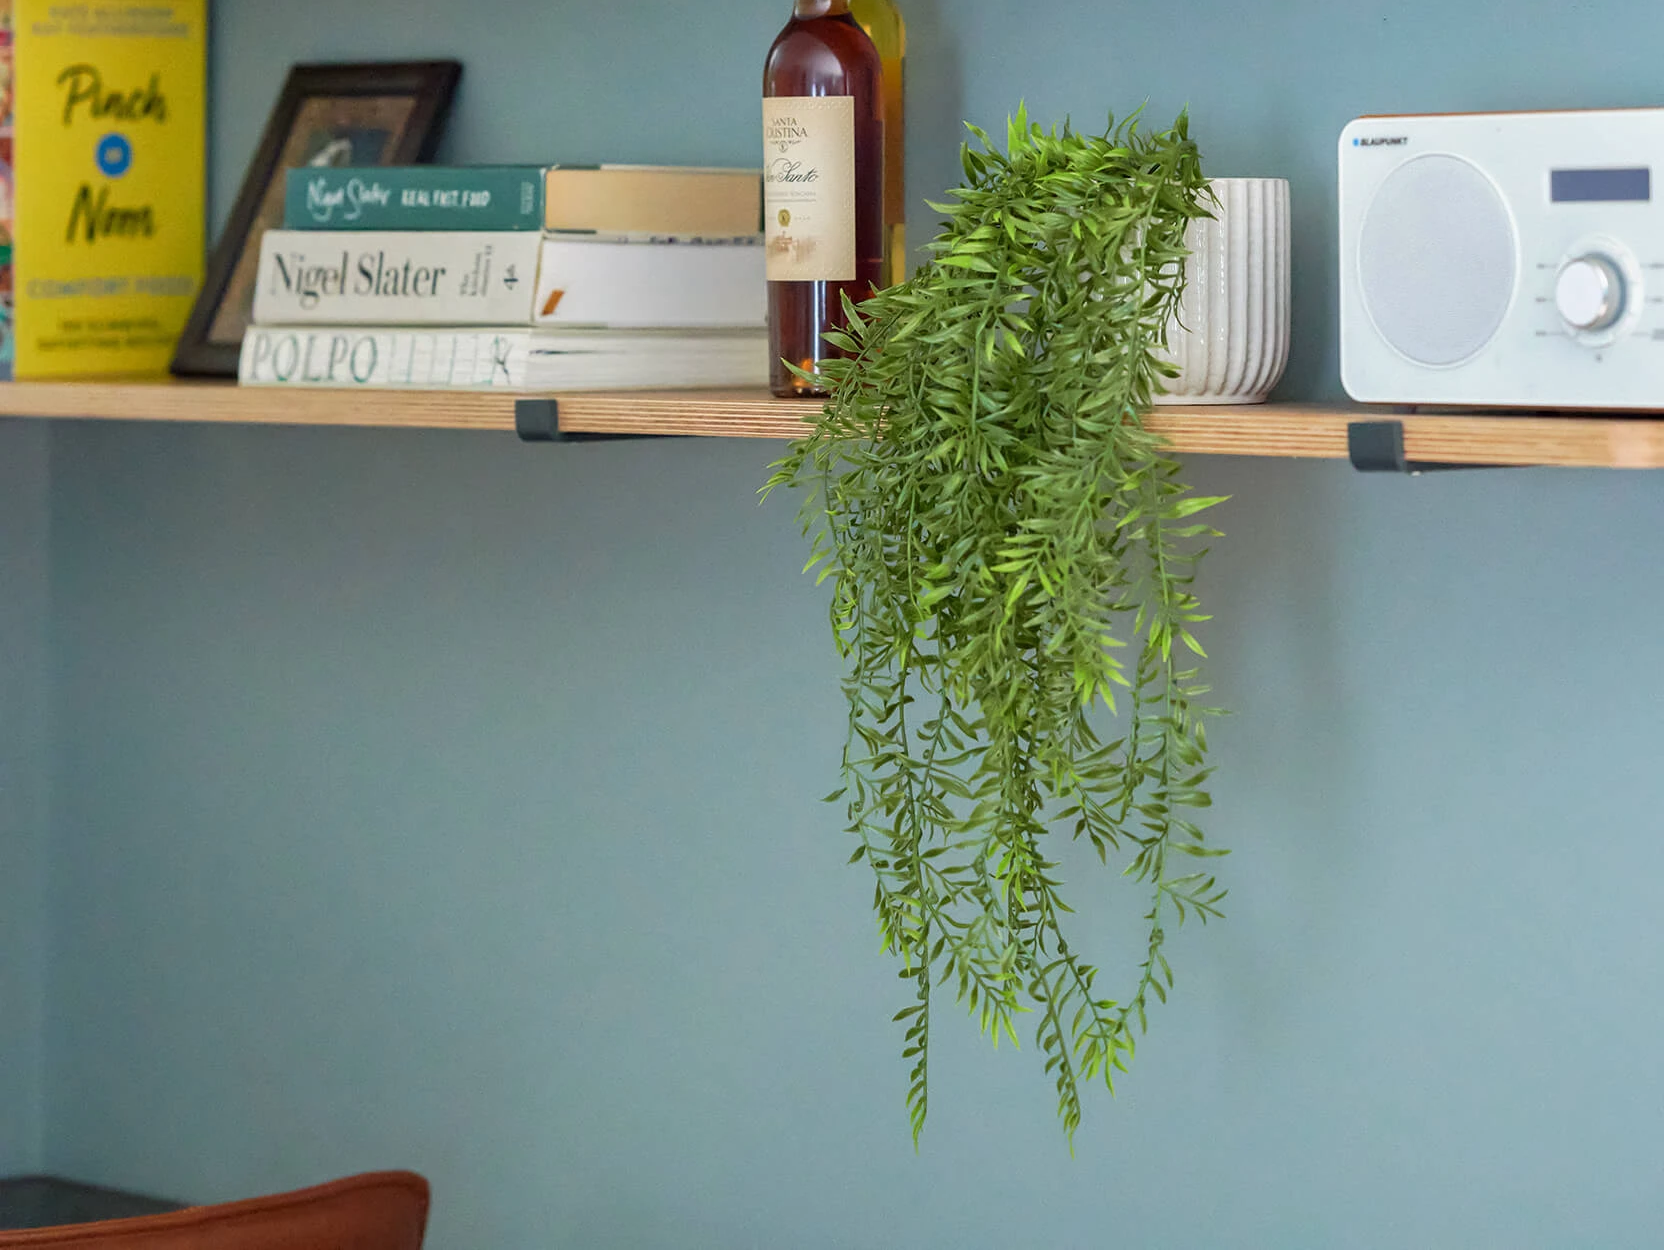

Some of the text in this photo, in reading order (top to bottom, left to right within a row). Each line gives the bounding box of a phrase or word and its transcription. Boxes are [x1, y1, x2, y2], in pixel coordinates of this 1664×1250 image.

[56, 63, 168, 126] Pinch
[270, 250, 349, 311] Nigel
[353, 250, 447, 297] Slater
[251, 333, 378, 384] POLPO
